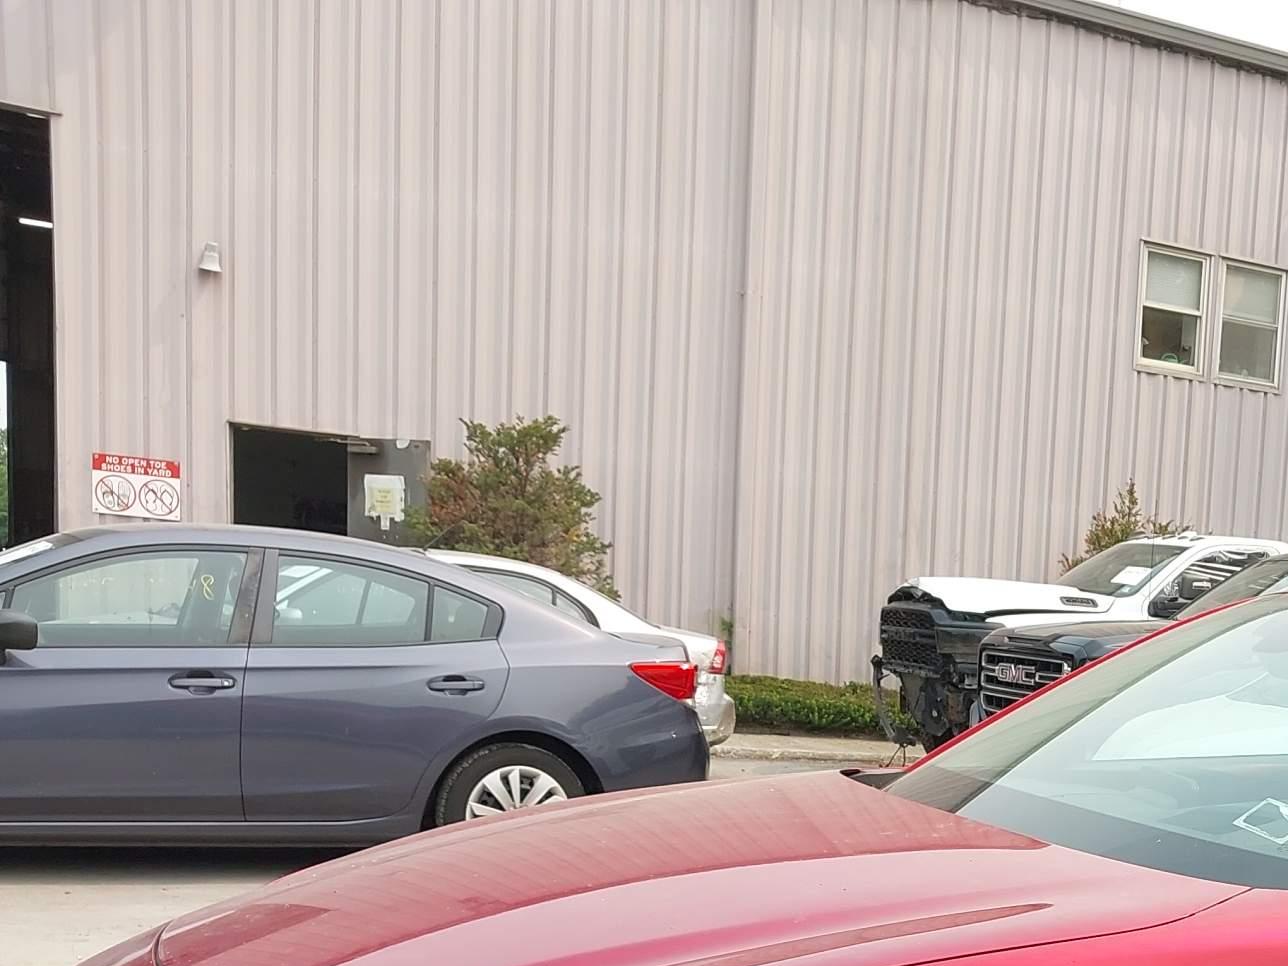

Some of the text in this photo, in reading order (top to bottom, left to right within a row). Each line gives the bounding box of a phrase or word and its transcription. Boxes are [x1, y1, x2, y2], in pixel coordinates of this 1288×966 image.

[105, 456, 167, 469] NO OPEN TOE
[101, 463, 172, 477] SHOES IN YARD
[995, 662, 1036, 686] GMC
